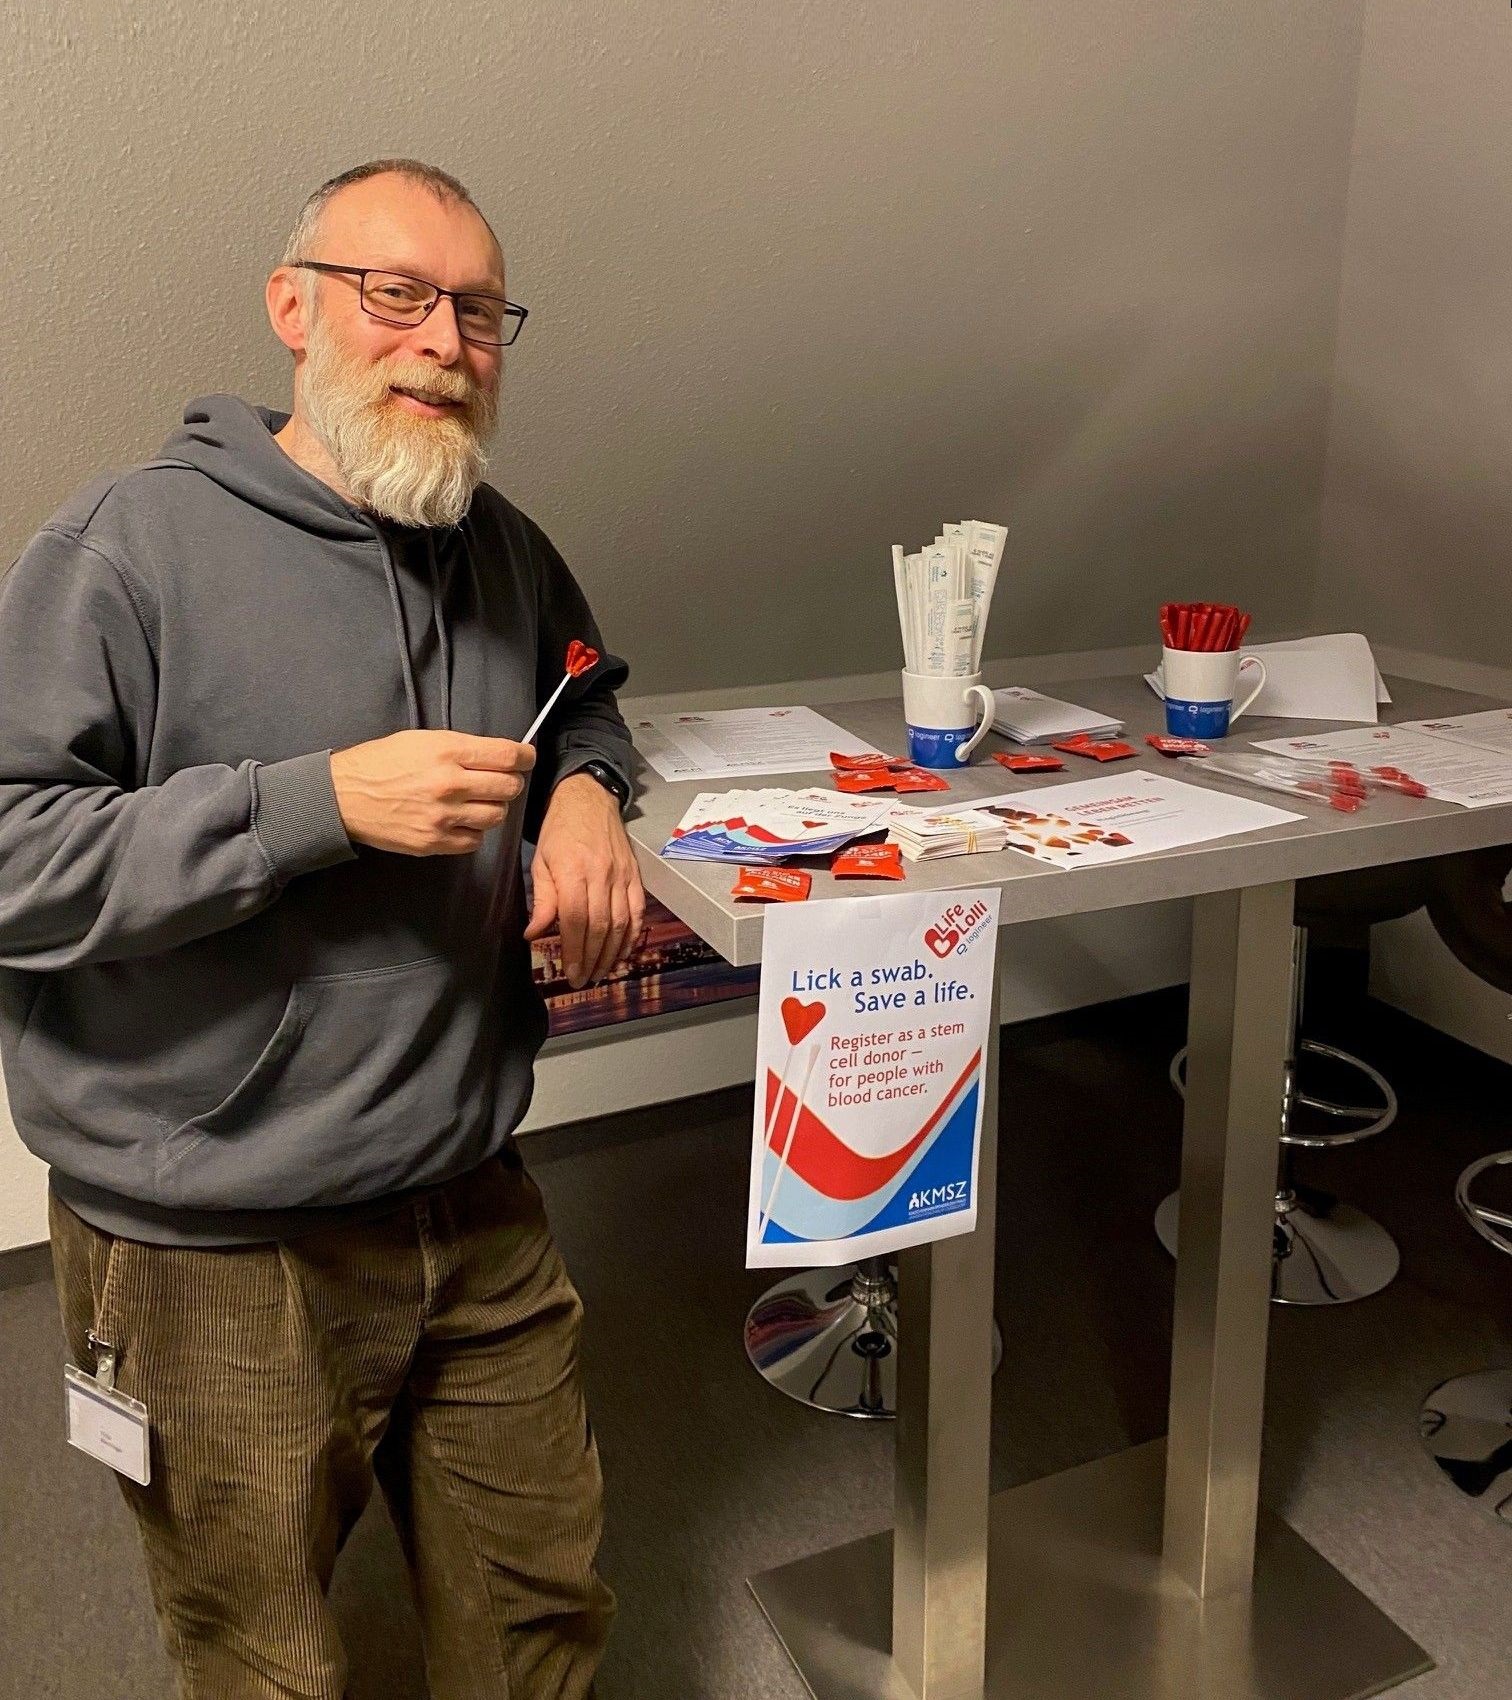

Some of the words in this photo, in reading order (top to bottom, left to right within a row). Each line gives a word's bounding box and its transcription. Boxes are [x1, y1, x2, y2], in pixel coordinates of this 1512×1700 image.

[1065, 796, 1136, 811] GEMEINSAM
[1117, 797, 1165, 809] RETTEN
[934, 904, 964, 935] Life
[956, 900, 988, 935] Lolli
[966, 915, 993, 944] logineer
[792, 968, 842, 991] Lick
[850, 971, 863, 987] a
[871, 959, 933, 985] swab.
[855, 991, 906, 1013] Save
[914, 989, 926, 1005] a
[935, 980, 975, 1003] life.
[831, 1032, 893, 1051] Register
[898, 1030, 913, 1042] as
[917, 1028, 926, 1039] a
[931, 1022, 965, 1037] stem
[829, 1053, 858, 1069] cell
[863, 1049, 907, 1066] donor
[829, 1073, 852, 1088] for
[857, 1066, 907, 1088] people
[912, 1059, 944, 1076] with
[828, 1089, 871, 1107] blood
[876, 1082, 928, 1101] cancer.
[920, 1181, 967, 1208] KMSZ
